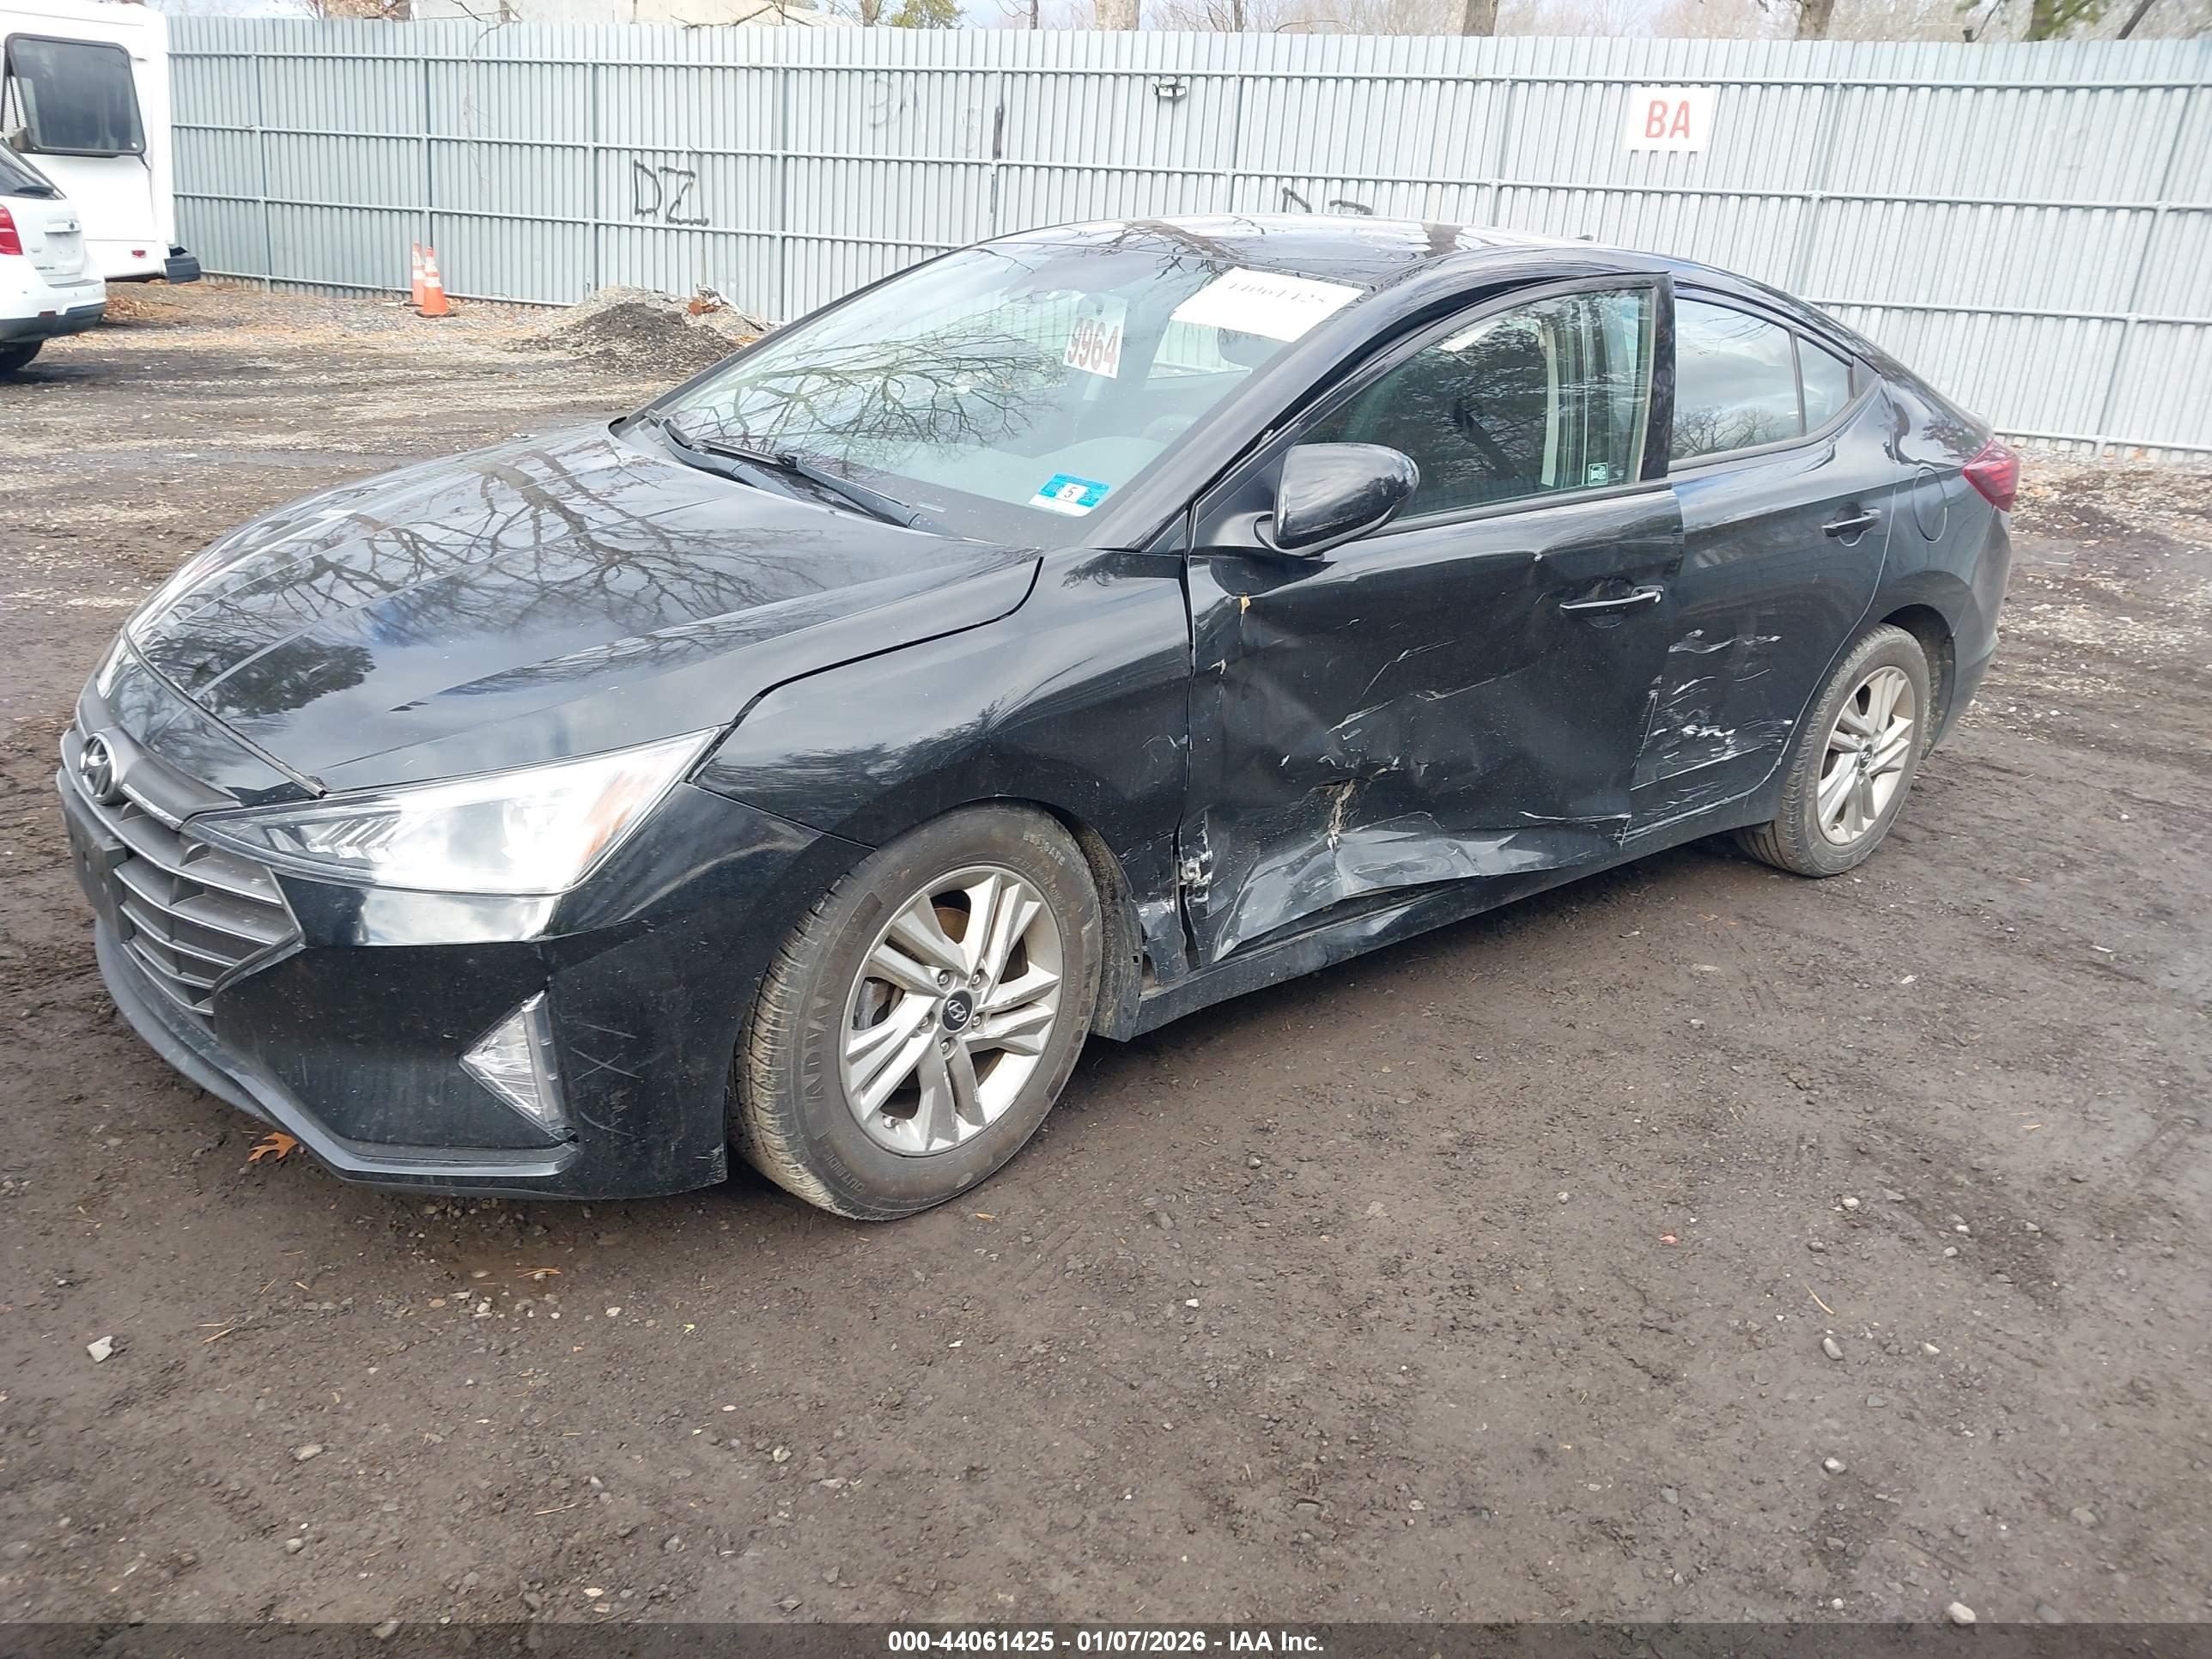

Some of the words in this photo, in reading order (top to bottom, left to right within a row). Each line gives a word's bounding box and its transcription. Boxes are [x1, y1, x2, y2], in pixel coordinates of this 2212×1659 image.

[1644, 99, 1690, 139] BA
[633, 158, 709, 227] DZ
[1066, 317, 1120, 374] 9964
[1063, 486, 1079, 499] 5
